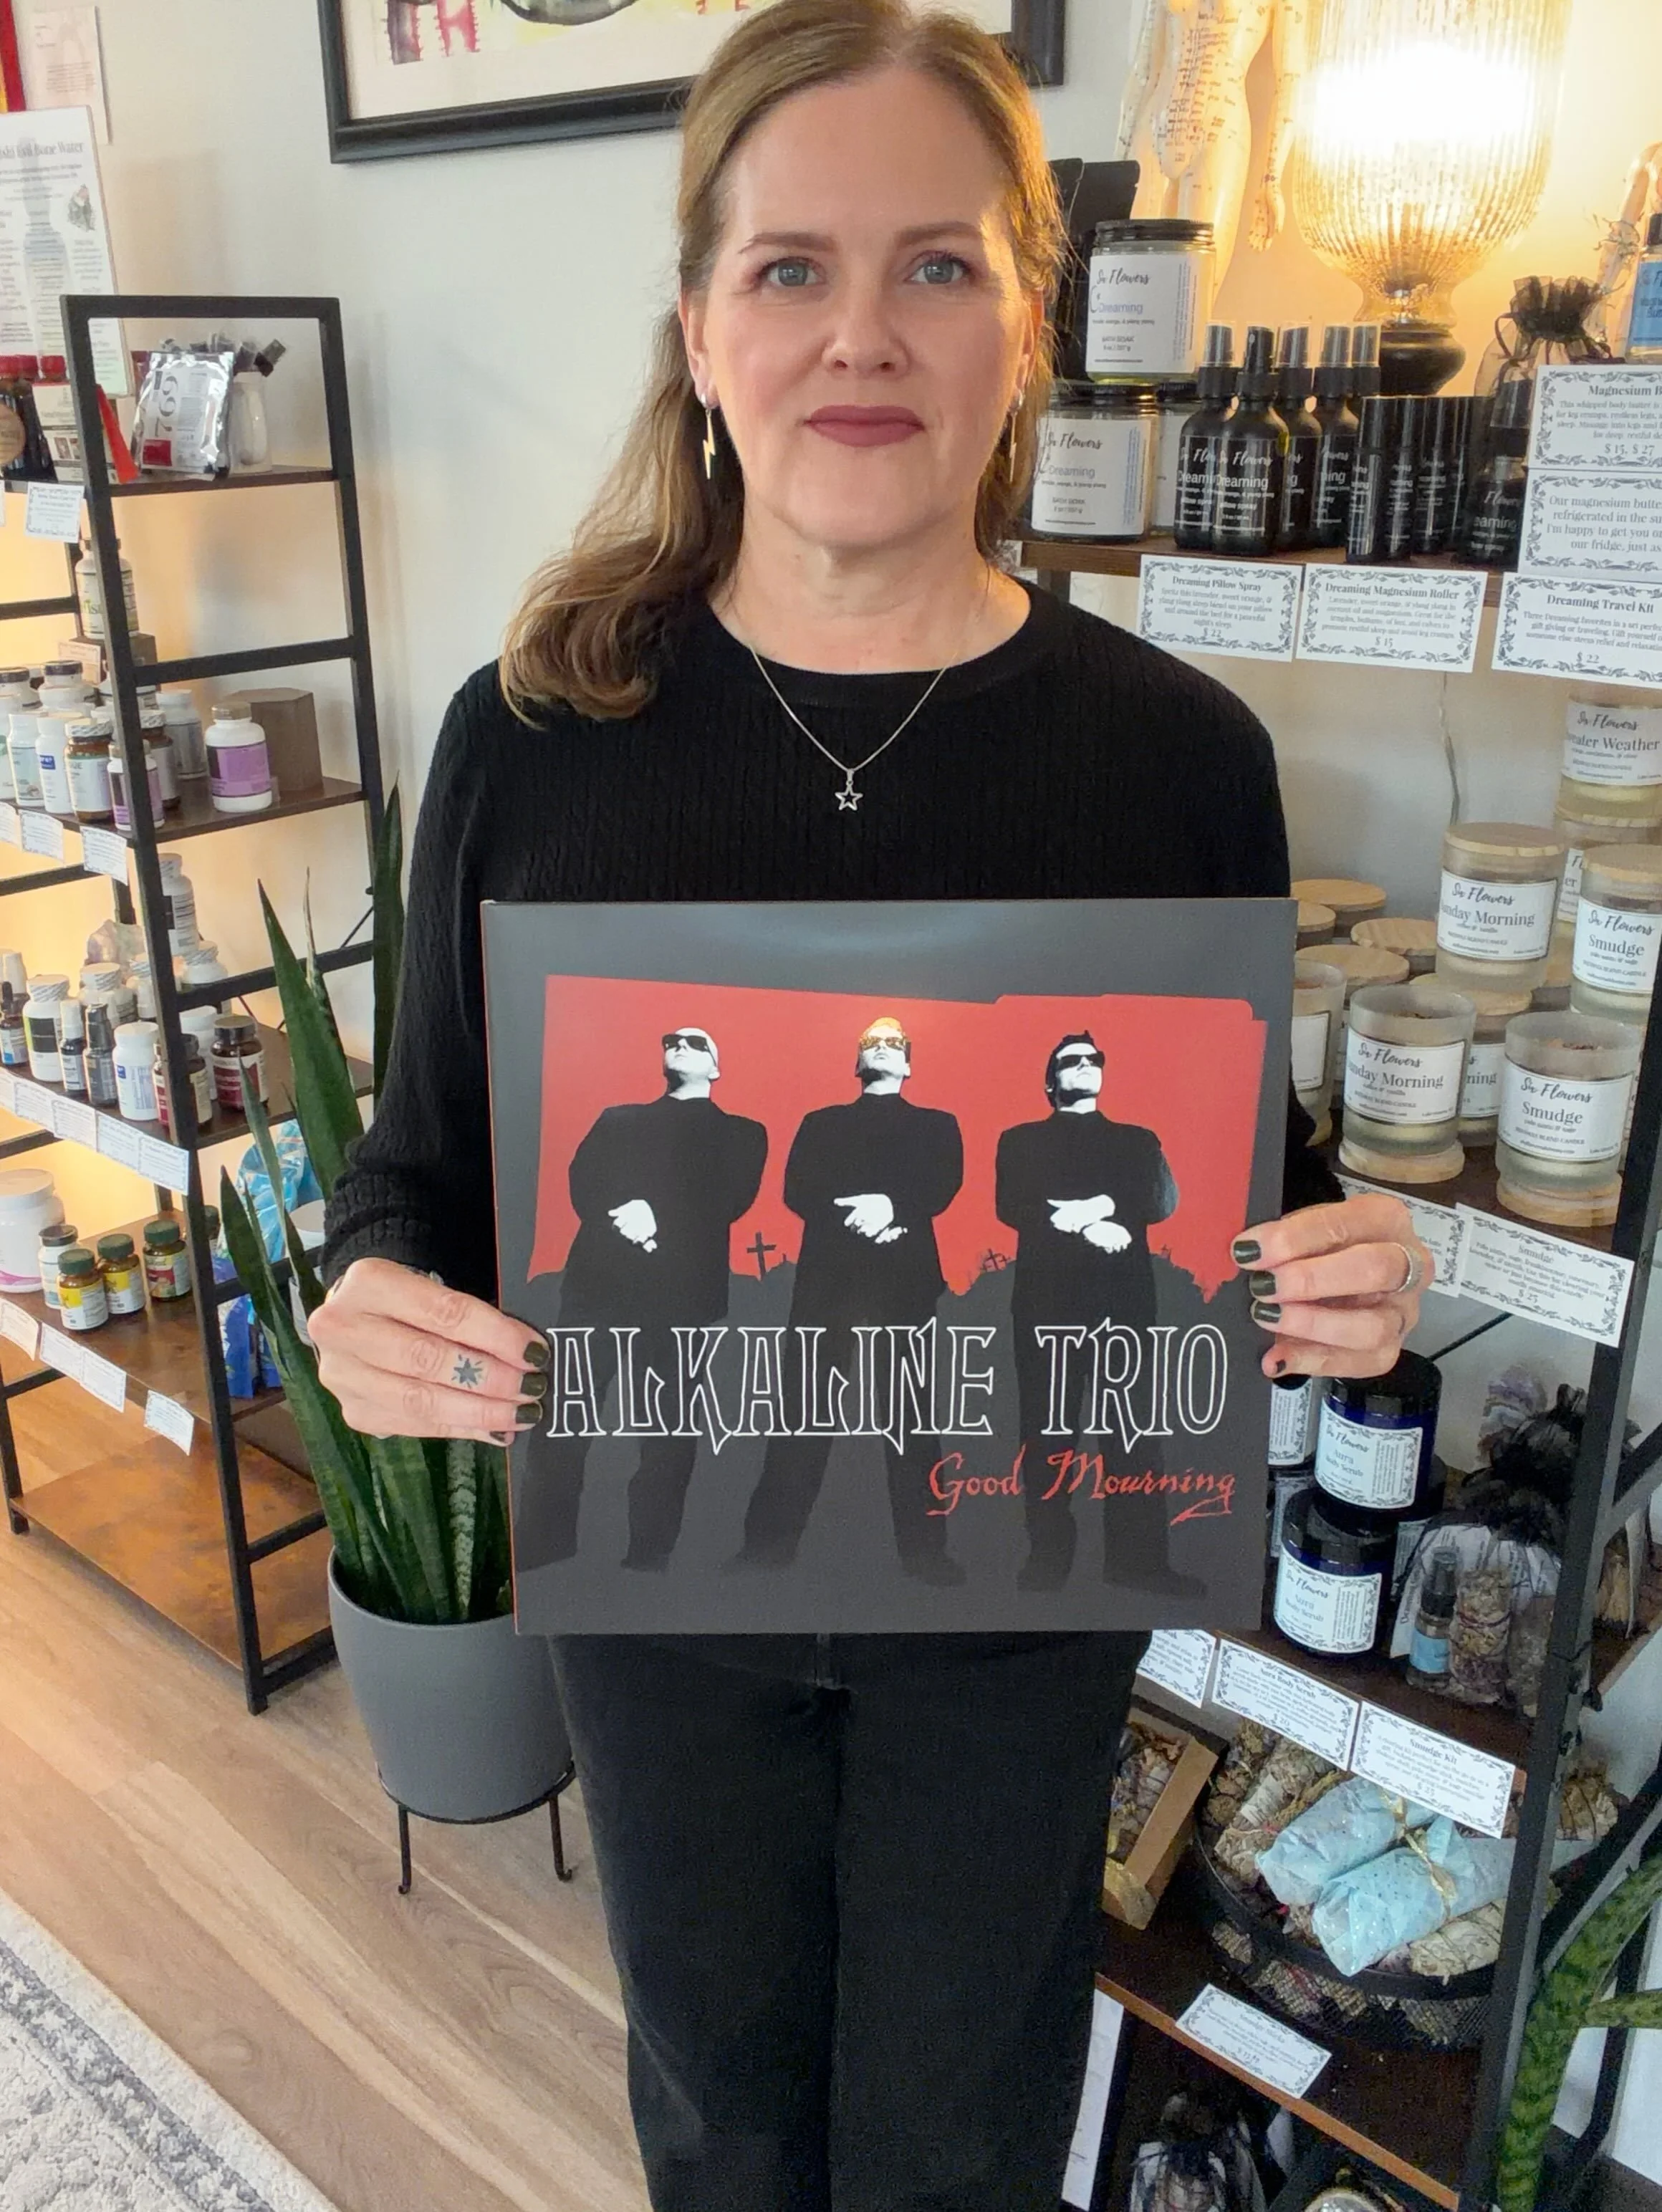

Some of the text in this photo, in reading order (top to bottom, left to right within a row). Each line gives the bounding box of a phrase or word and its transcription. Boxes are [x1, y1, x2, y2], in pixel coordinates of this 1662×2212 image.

[1110, 267, 1152, 285] Flowers
[1097, 303, 1143, 314] Dreaming
[1588, 384, 1651, 397] Magnesium
[1060, 431, 1103, 450] Flowers
[1233, 451, 1273, 466] Flowers
[1642, 445, 1656, 456] 27
[1049, 465, 1095, 479] Dreaming
[1217, 473, 1269, 490] Dreaming
[1549, 495, 1568, 505] Our
[1571, 497, 1630, 509] magnesium
[1552, 509, 1613, 522] refrigerated
[1616, 512, 1626, 521] in
[1630, 512, 1647, 522] the
[1547, 523, 1562, 533] I'm
[1564, 524, 1593, 537] happy
[1598, 526, 1608, 535] to
[1610, 527, 1626, 537] get
[1630, 529, 1649, 539] you
[1570, 540, 1589, 549] our
[1626, 542, 1647, 553] just
[1172, 575, 1261, 593] Dreaming Pillow Spray
[1325, 582, 1459, 600] Dreaming Magnesium Roller
[1547, 595, 1654, 613] Dreaming Travel Kit
[1545, 612, 1579, 624] Dreaming
[1581, 616, 1611, 626] favorites
[1526, 630, 1556, 640] someone
[1545, 622, 1565, 633] giving
[1627, 630, 1656, 641] yourself
[1384, 637, 1393, 647] 15
[1586, 653, 1599, 663] 22
[1593, 713, 1638, 731] Flowers
[1603, 737, 1660, 751] Weather
[1467, 886, 1515, 905] Flowers
[1476, 910, 1535, 927] Morning
[1605, 915, 1655, 936] Flowers
[1588, 933, 1645, 958] Smudge
[1374, 1048, 1423, 1068] Flowers
[1383, 1072, 1444, 1089] Morning
[1541, 1083, 1593, 1104] Flowers
[1522, 1101, 1583, 1125] Smudge
[1517, 1244, 1554, 1264] Smudge
[546, 1317, 1228, 1456] ALKALINE TRIO
[1335, 1432, 1370, 1453] Flowers
[926, 1444, 1236, 1526] Good Mourning
[1296, 1577, 1330, 1599] Flowers
[1408, 1737, 1457, 1764] Smudge Kit
